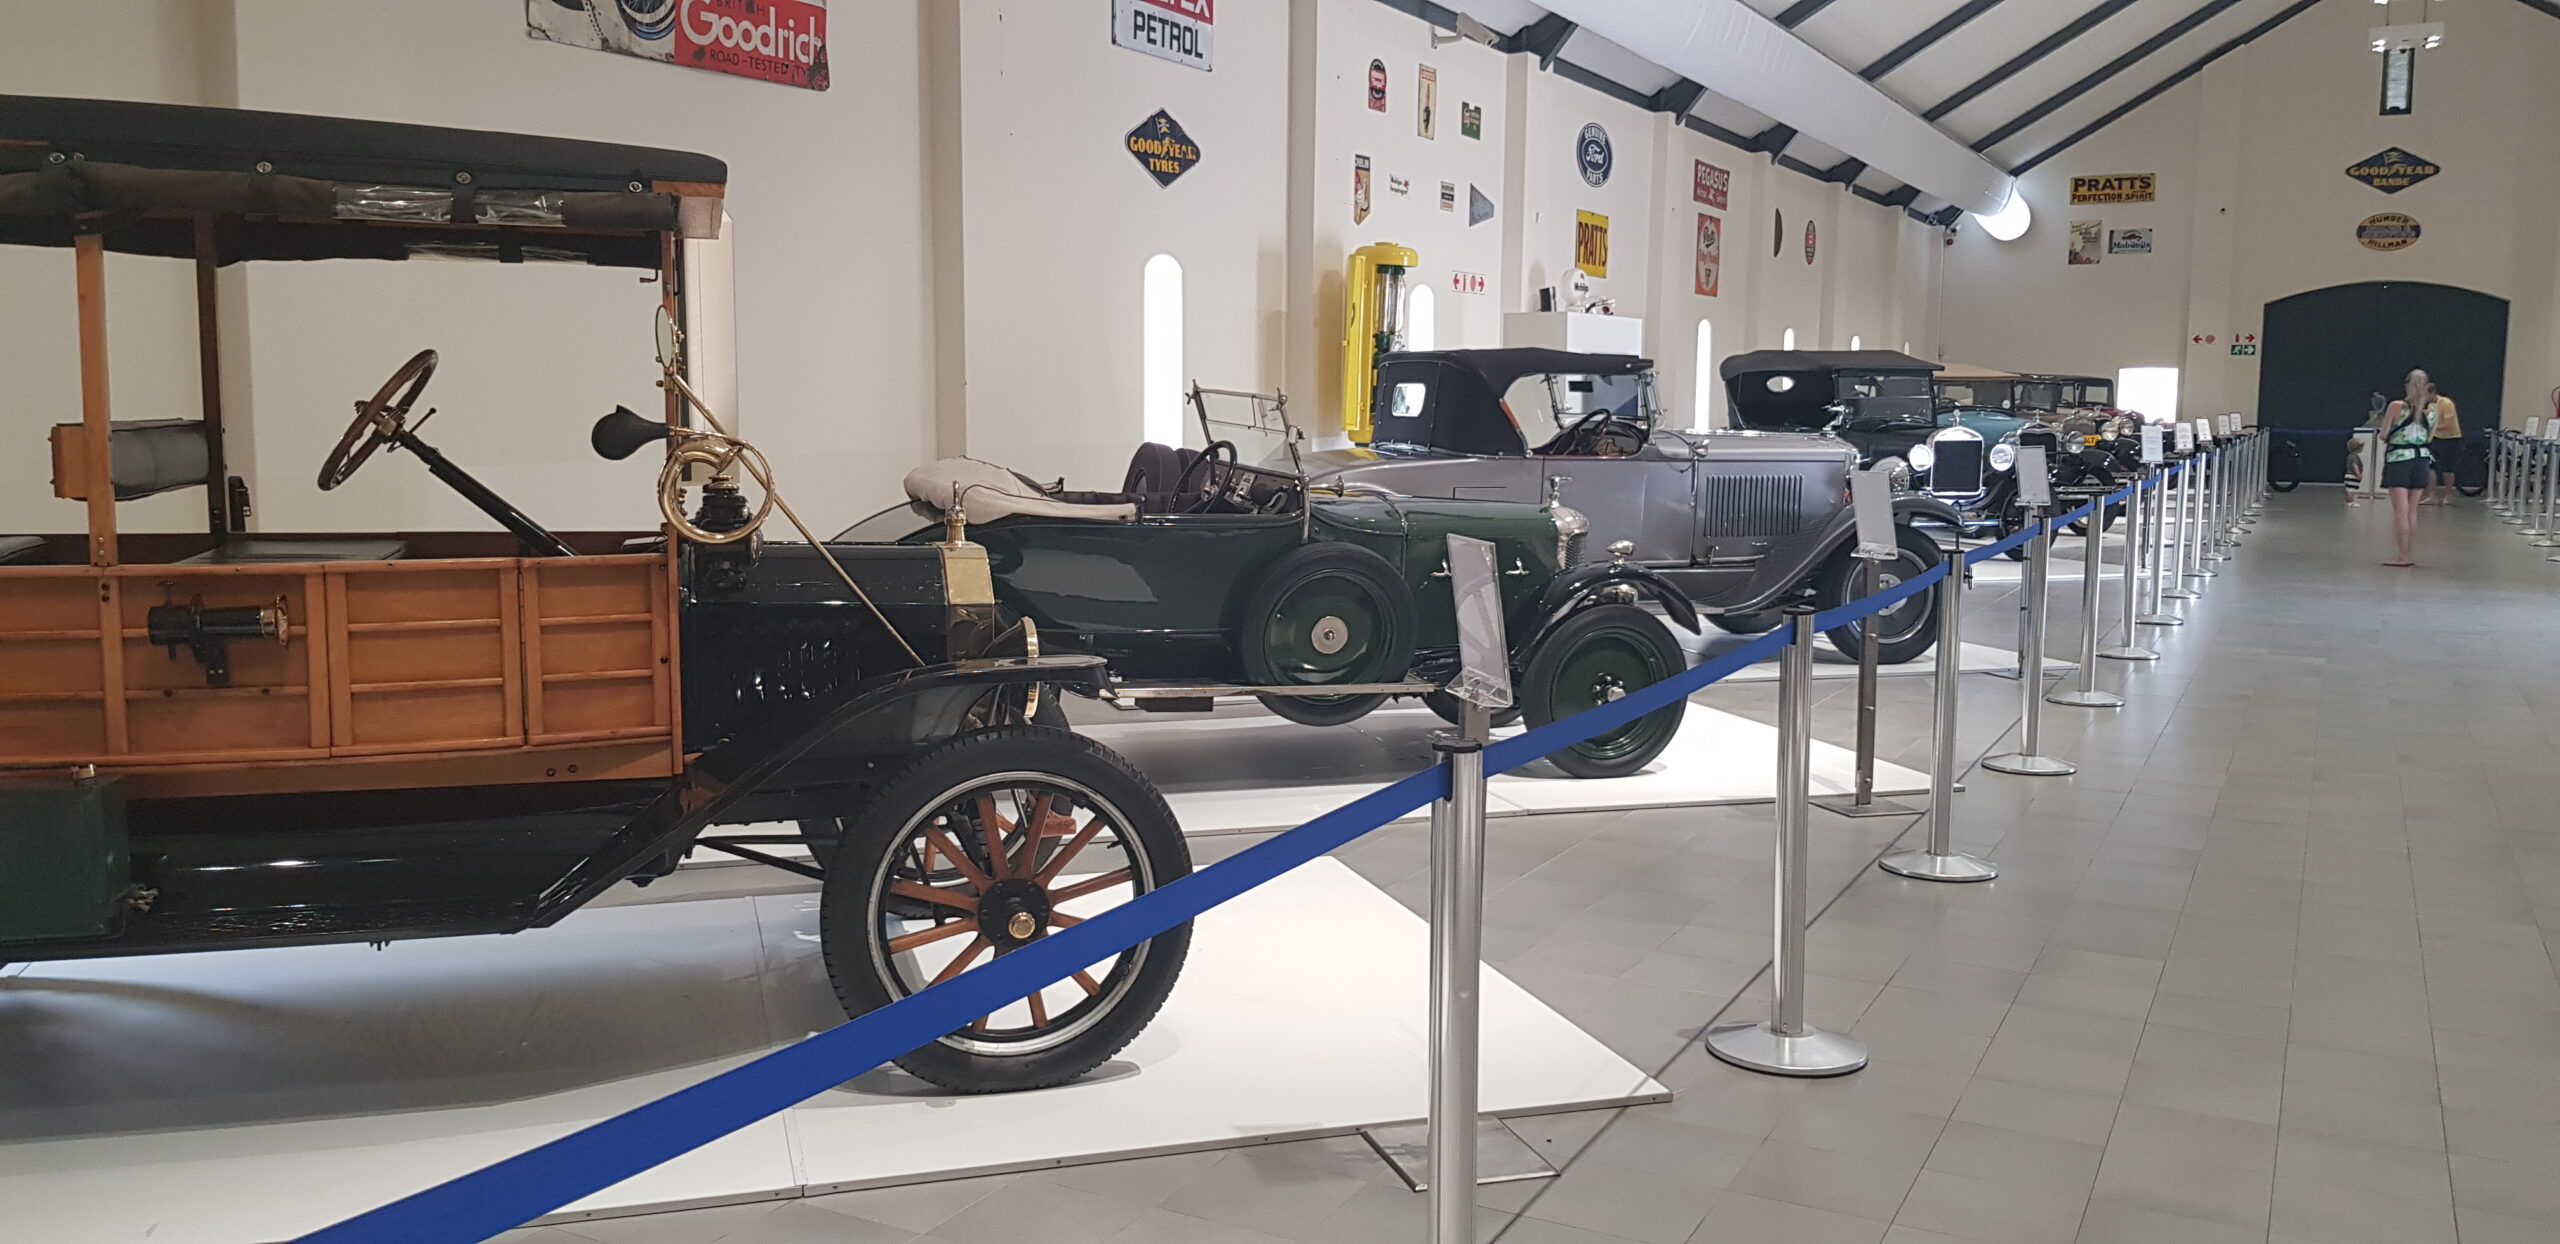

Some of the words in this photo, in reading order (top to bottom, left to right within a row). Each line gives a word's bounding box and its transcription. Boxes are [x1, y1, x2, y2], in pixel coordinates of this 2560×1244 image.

[680, 0, 823, 65] Goodrich
[1133, 9, 1203, 59] PETROL
[1585, 127, 1605, 145] GENUINE
[1585, 144, 1605, 164] Ford
[1149, 157, 1180, 174] TYRES
[2350, 165, 2435, 176] GOODYEAR
[1587, 170, 1603, 185] PARTS
[1697, 164, 1729, 192] PEGASUS
[2072, 193, 2122, 203] PERFECTION
[2125, 191, 2154, 201] SPIRIT
[2367, 239, 2408, 249] HILLMAN
